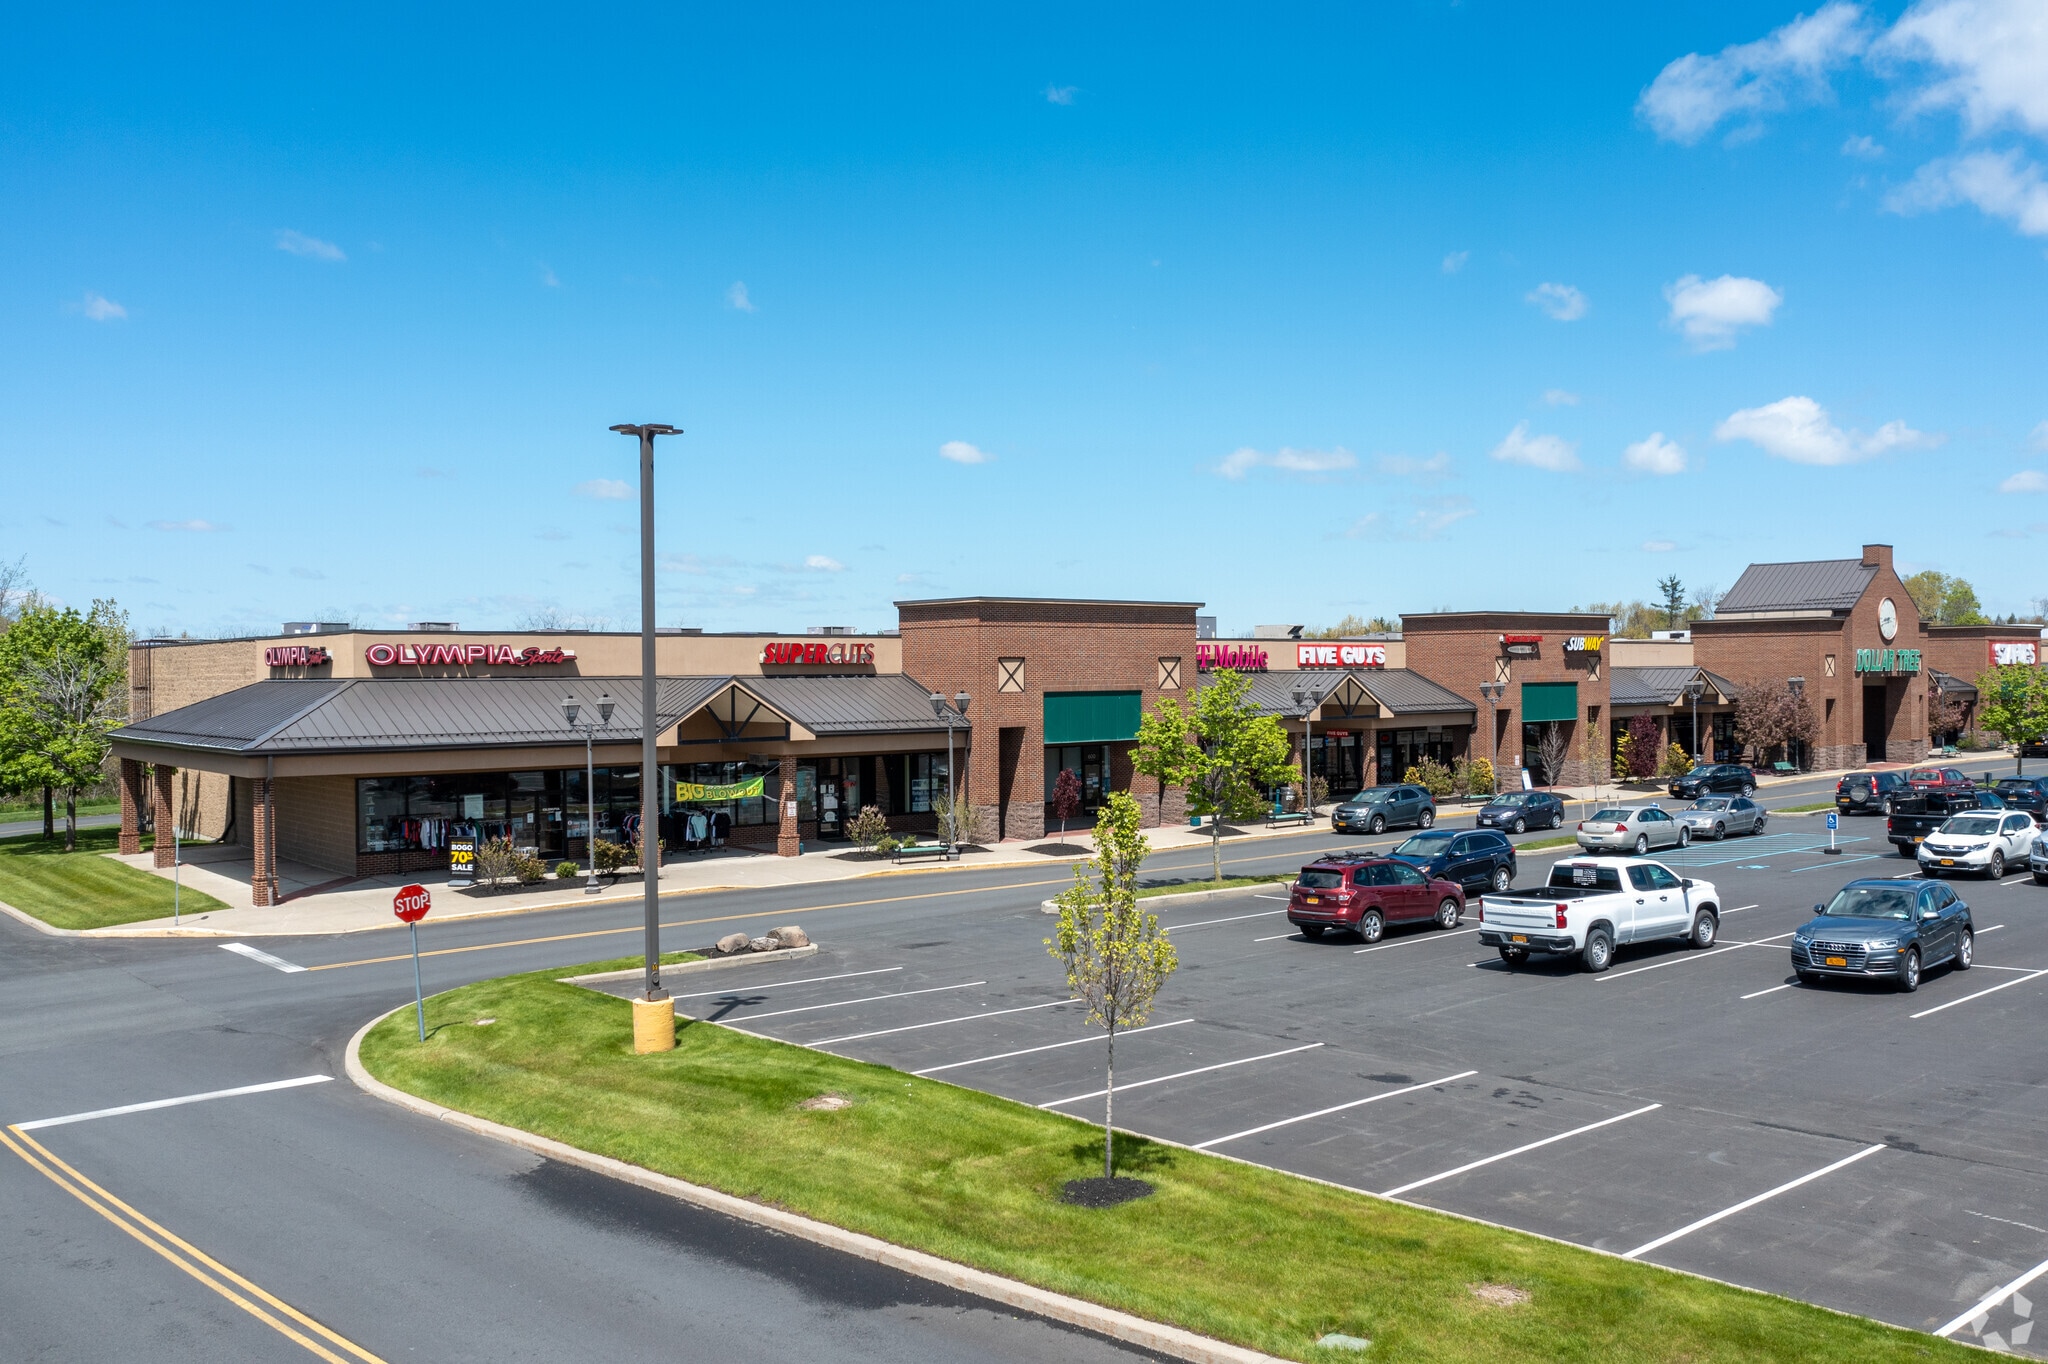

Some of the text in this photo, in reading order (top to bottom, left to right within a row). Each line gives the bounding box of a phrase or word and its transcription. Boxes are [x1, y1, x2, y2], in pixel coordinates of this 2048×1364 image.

[1567, 636, 1604, 651] SUBWAY
[265, 646, 306, 666] OLYMPIA
[366, 644, 576, 667] OLYMPIA Sports
[1299, 646, 1386, 665] FIVE GUYS
[1856, 648, 1920, 672] DOLLAR TREE
[676, 783, 704, 801] BIG
[706, 786, 760, 799] BLOWOUT
[451, 863, 474, 871] SALE
[396, 894, 429, 913] STOP
